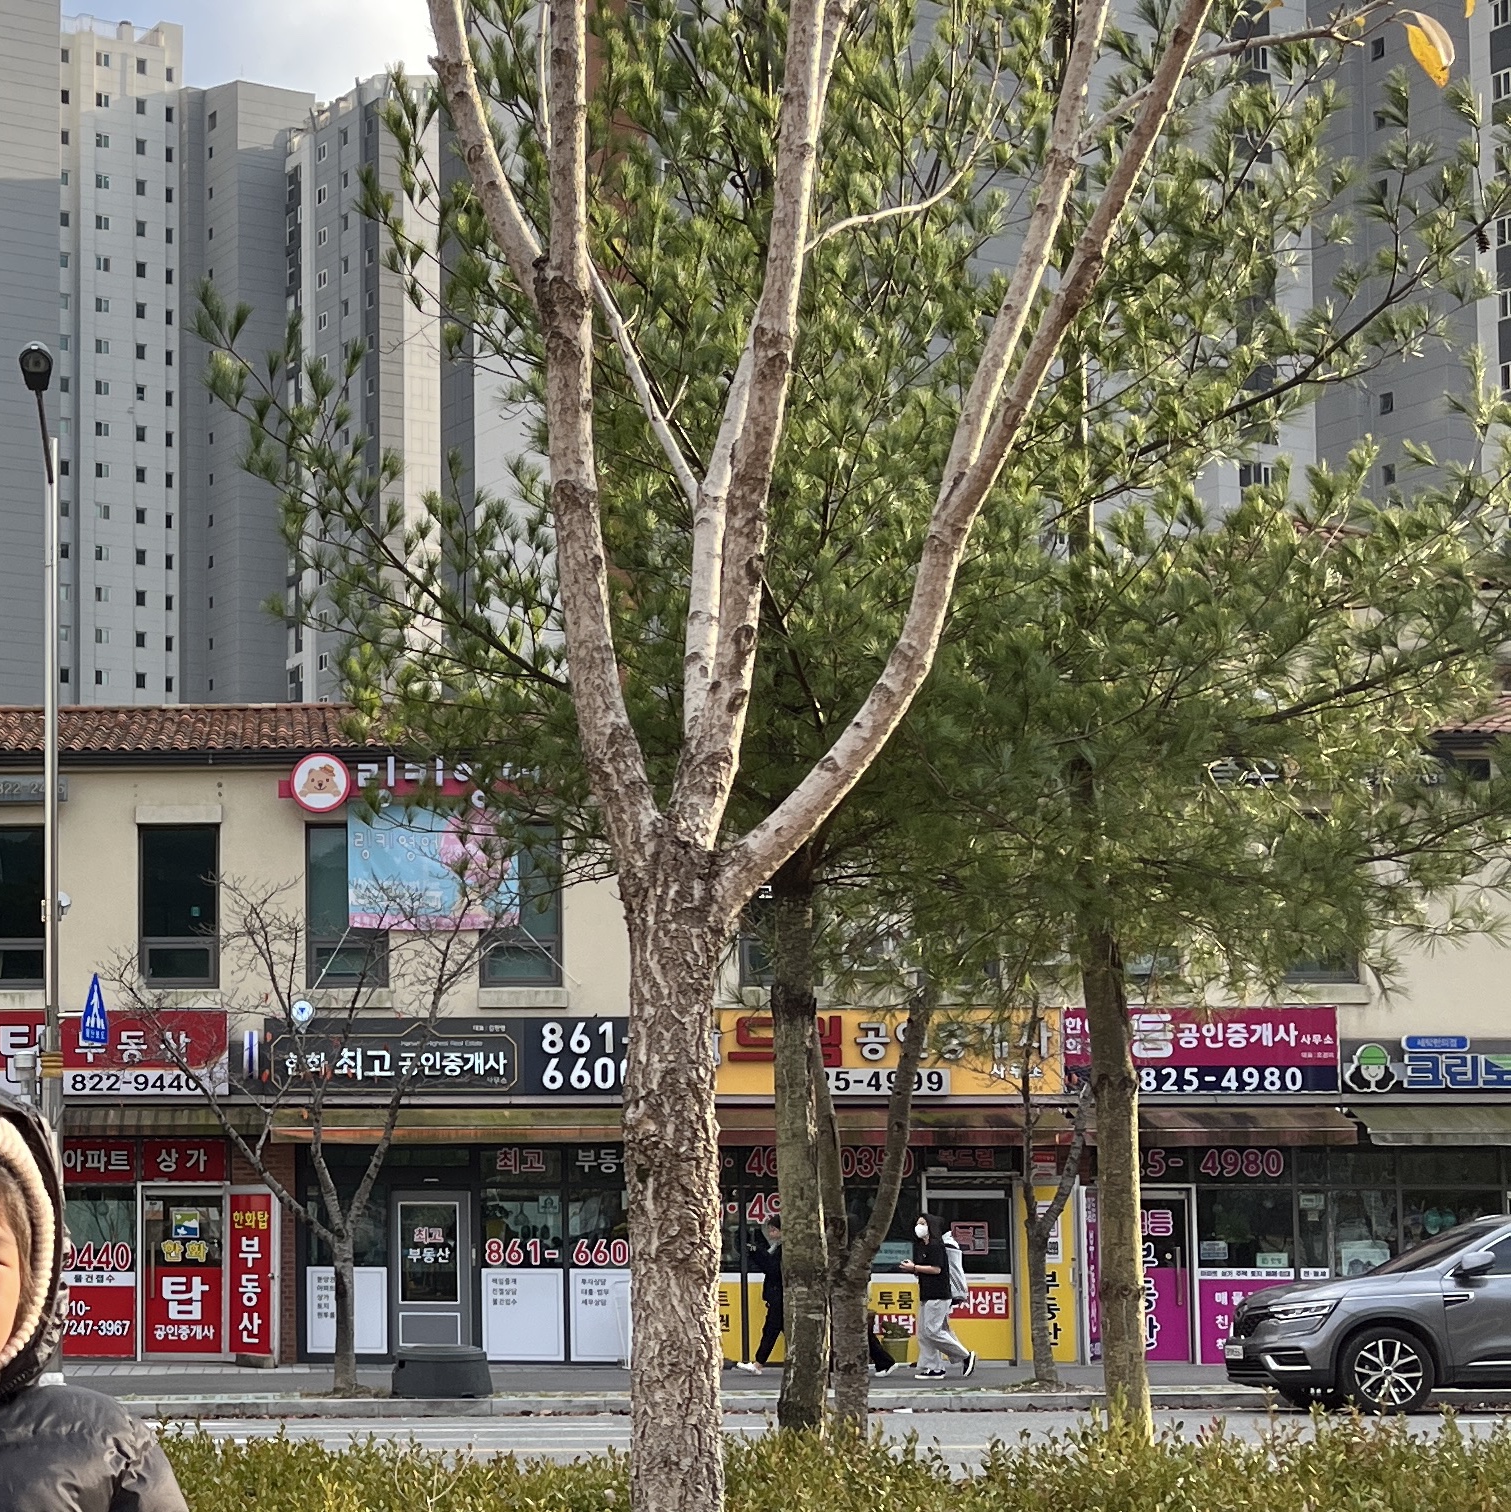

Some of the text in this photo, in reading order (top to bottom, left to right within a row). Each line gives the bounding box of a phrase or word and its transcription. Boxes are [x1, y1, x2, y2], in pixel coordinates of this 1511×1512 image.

[1175, 1022, 1299, 1049] 공인중개사
[1299, 1033, 1335, 1045] 사무소
[334, 1047, 396, 1081] 최고
[398, 1051, 508, 1076] 공인중개사
[70, 1072, 199, 1093] 822-9440
[1140, 1066, 1303, 1091] 825-4980
[62, 1148, 131, 1173] 아파트
[156, 1148, 208, 1173] 상가
[496, 1147, 626, 1175] 최고 부동
[1199, 1148, 1284, 1178] 4980
[232, 1210, 269, 1230] 한화탑
[413, 1226, 445, 1245] 최고
[161, 1239, 209, 1263] 한화
[407, 1246, 451, 1264] 부동산
[485, 1237, 629, 1266] 861- 660
[161, 1275, 210, 1321] 탑
[237, 1235, 262, 1344] 부동산
[877, 1291, 914, 1310] 투룸
[67, 1299, 91, 1317] 10-
[62, 1319, 131, 1337] 7247-3967
[152, 1324, 216, 1341] 공인중개사
